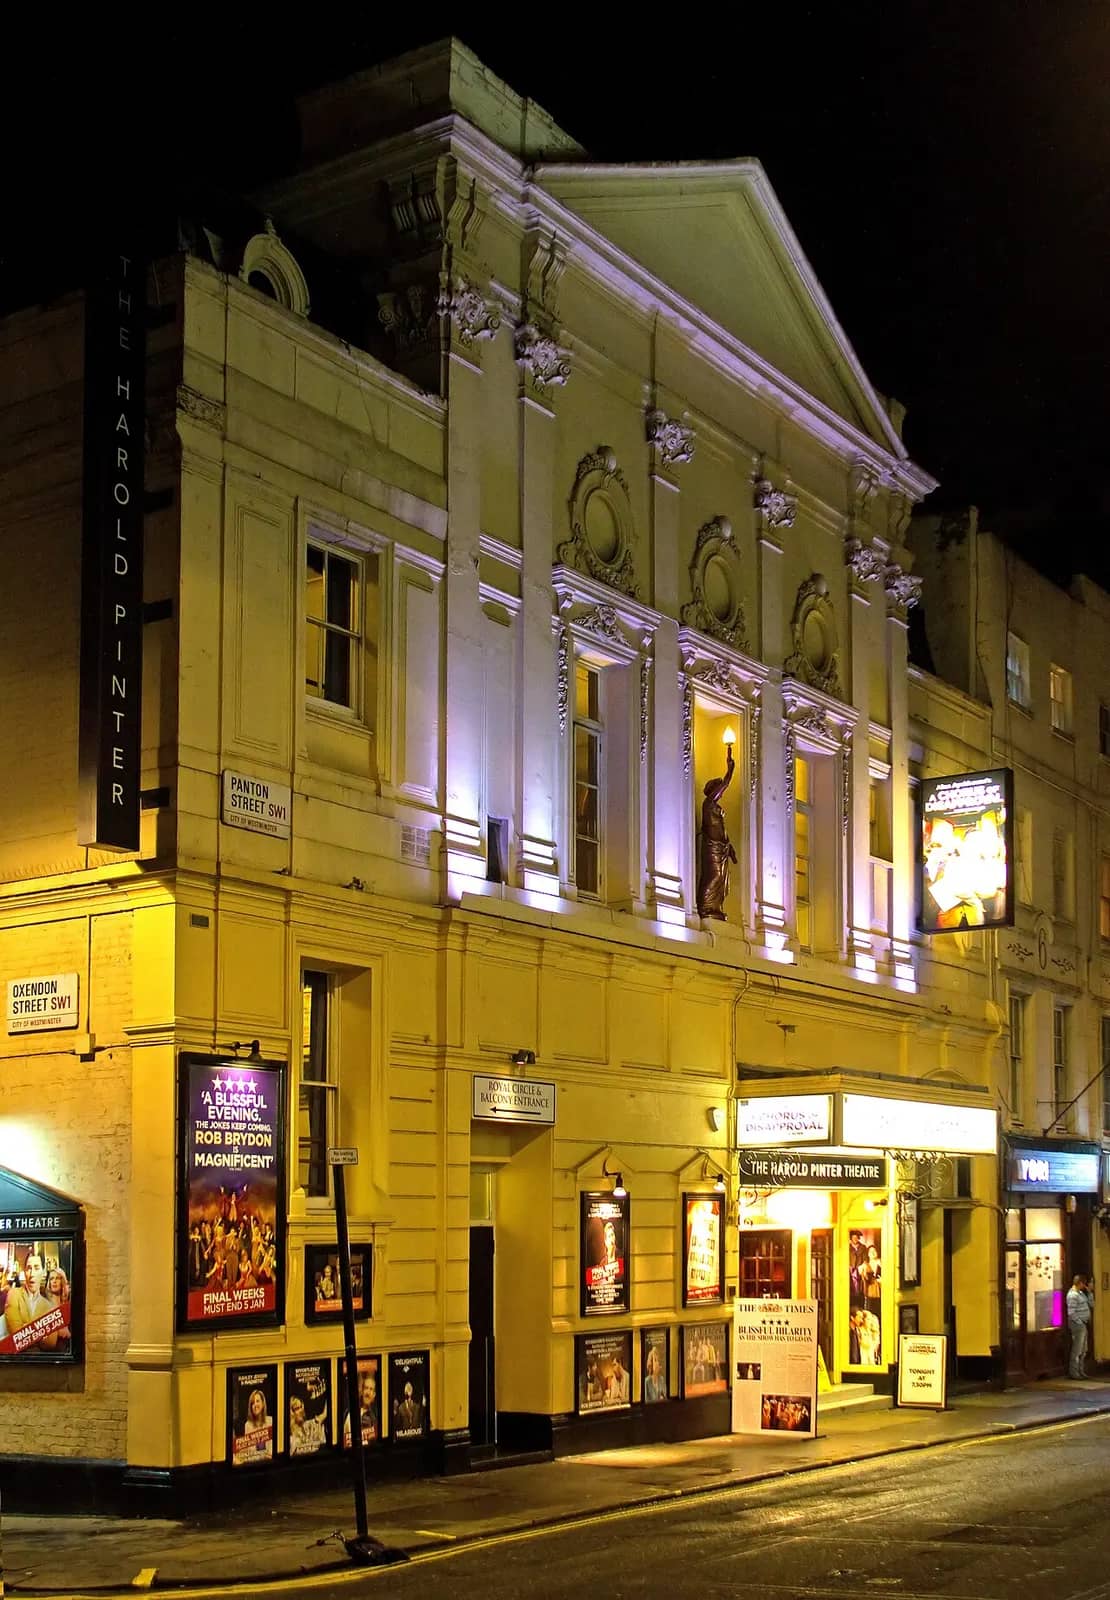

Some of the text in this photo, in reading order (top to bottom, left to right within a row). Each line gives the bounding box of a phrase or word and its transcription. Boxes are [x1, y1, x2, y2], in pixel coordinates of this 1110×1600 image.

[114, 376, 130, 576] HAROLD
[112, 604, 126, 806] PINTER
[232, 777, 268, 799] PANTON
[232, 794, 286, 820] STREET SW1
[230, 815, 240, 823] CITY
[13, 980, 58, 998] OXENDON
[13, 995, 70, 1014] STREET SW1
[30, 1017, 61, 1026] WESTMINSTER
[488, 1081, 542, 1096] ROYAL CIRCLE &
[215, 1091, 267, 1109] BLISSFUL
[480, 1092, 549, 1108] BALCONY ENTRANCE
[196, 1120, 208, 1129] THE
[210, 1122, 230, 1130] JOKES
[231, 1122, 246, 1131] KEEP
[195, 1131, 272, 1147] ROB BRYDON
[751, 1160, 879, 1178] THE HAROLD PINTER THEATRE
[16, 1217, 60, 1228] THEATRE
[203, 1287, 265, 1304] FINAL WEEKS
[204, 1299, 264, 1315] MUST END 5 JAN
[739, 1304, 757, 1312] THE
[785, 1305, 814, 1313] TIMES
[13, 1309, 62, 1343] FINAL WEEKS
[16, 1335, 31, 1351] MUST
[32, 1328, 45, 1340] END
[52, 1317, 64, 1330] JAN
[739, 1326, 812, 1336] BLISSFUL HILARITY
